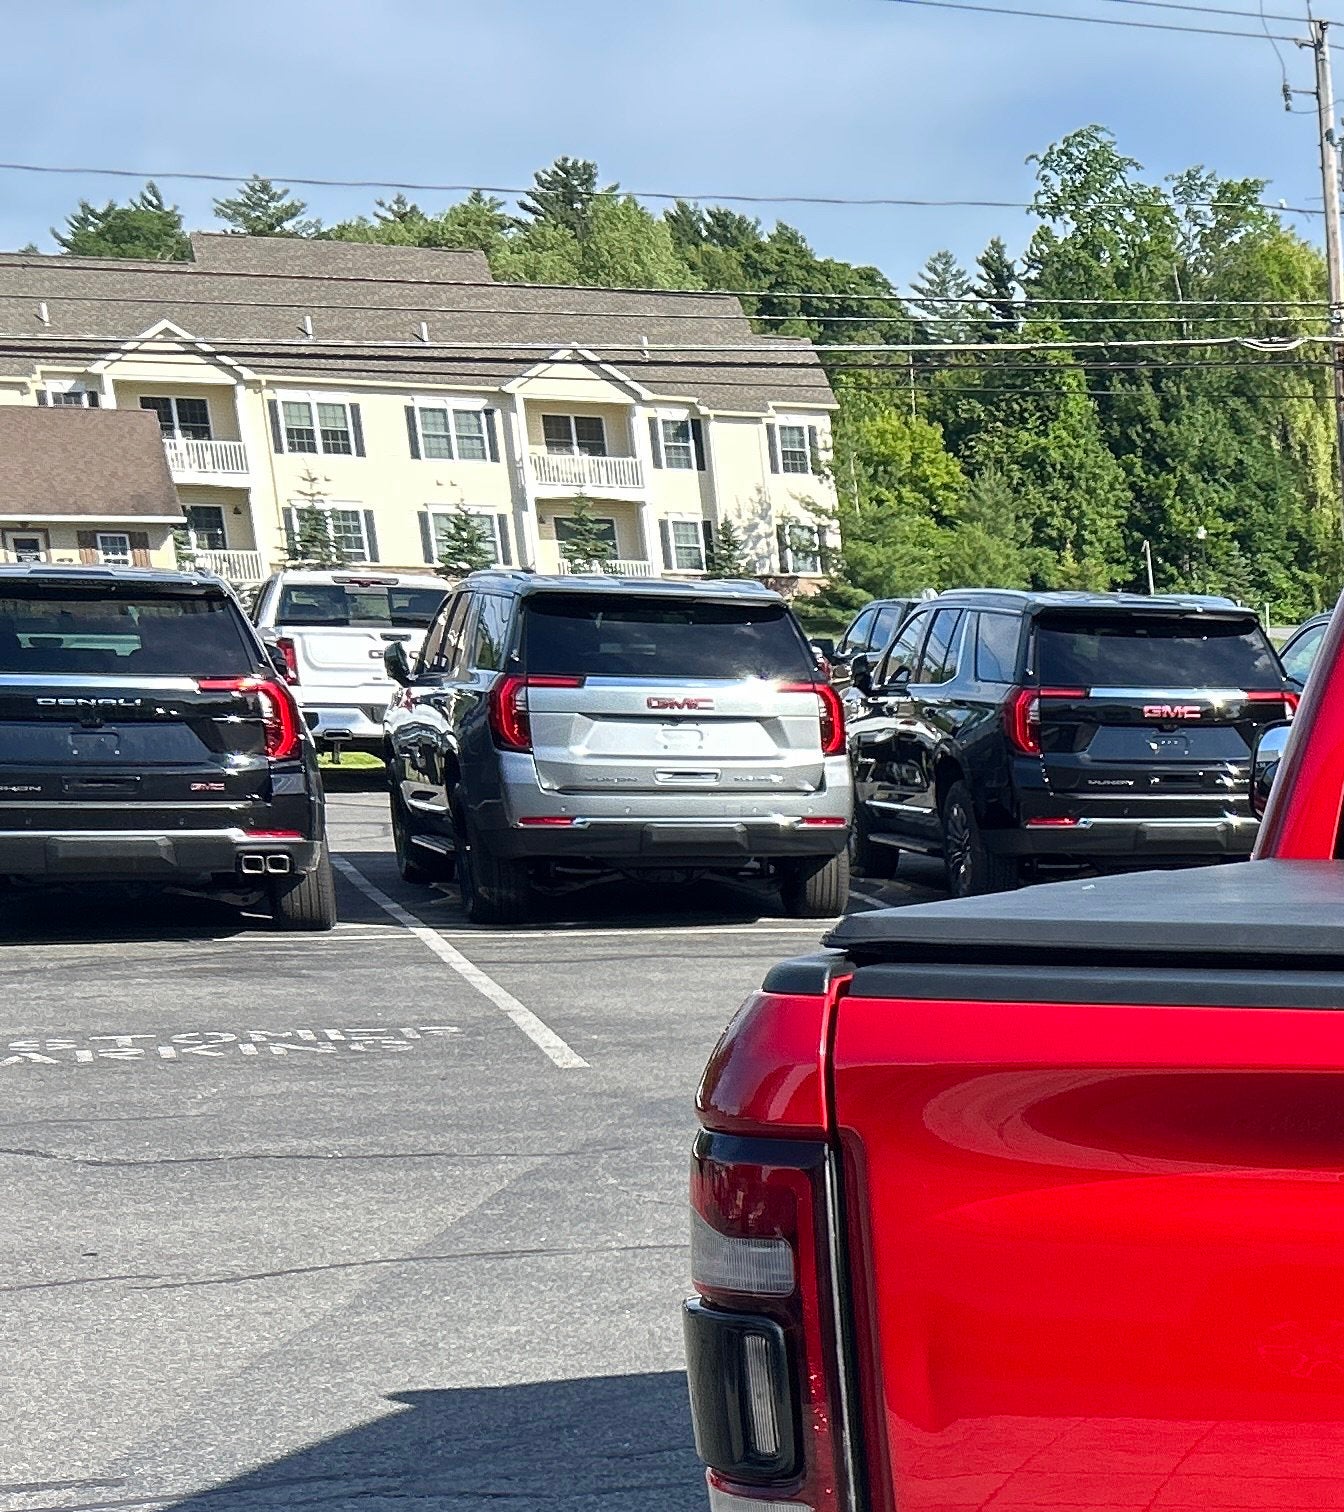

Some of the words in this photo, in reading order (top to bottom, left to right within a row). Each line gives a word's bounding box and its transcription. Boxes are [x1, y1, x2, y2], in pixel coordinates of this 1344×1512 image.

[36, 697, 142, 707] DENALI
[646, 697, 714, 710] GMC
[1143, 705, 1201, 719] GMC
[190, 782, 225, 791] GMC
